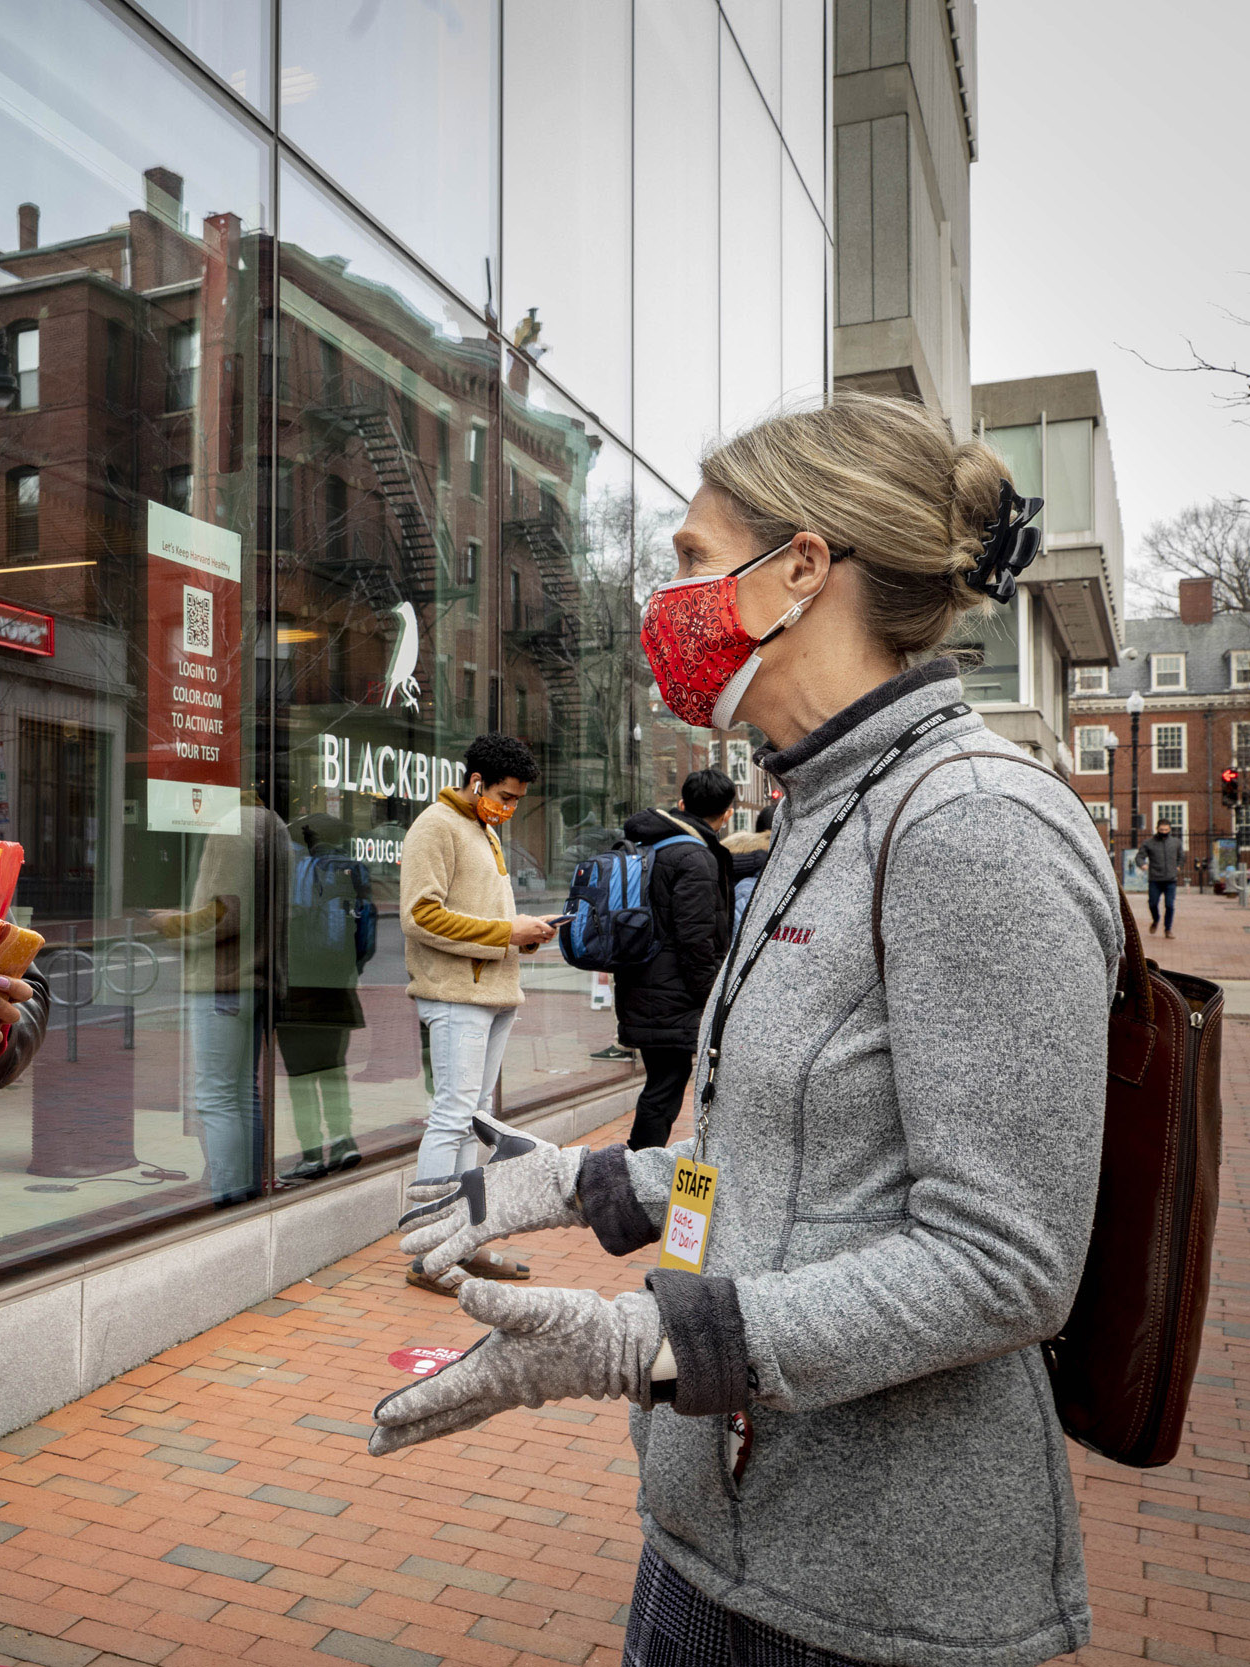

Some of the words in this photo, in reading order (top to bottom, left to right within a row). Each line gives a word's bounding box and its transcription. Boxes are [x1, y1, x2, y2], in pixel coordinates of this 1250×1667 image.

[161, 540, 175, 554] Let's
[176, 545, 190, 560] Keep
[190, 550, 211, 566] Harvard
[211, 557, 231, 575] Healthy
[178, 660, 205, 680] LOGIN
[206, 666, 218, 682] TO
[172, 685, 223, 709] COLOR.COM
[171, 712, 184, 729] TO
[185, 714, 223, 735] ACTIVATE
[176, 741, 200, 760] YOUR
[201, 745, 220, 762] TEST
[676, 1168, 713, 1200] STAFF
[673, 1208, 694, 1230] Katie
[671, 1230, 699, 1251] O'Dair
